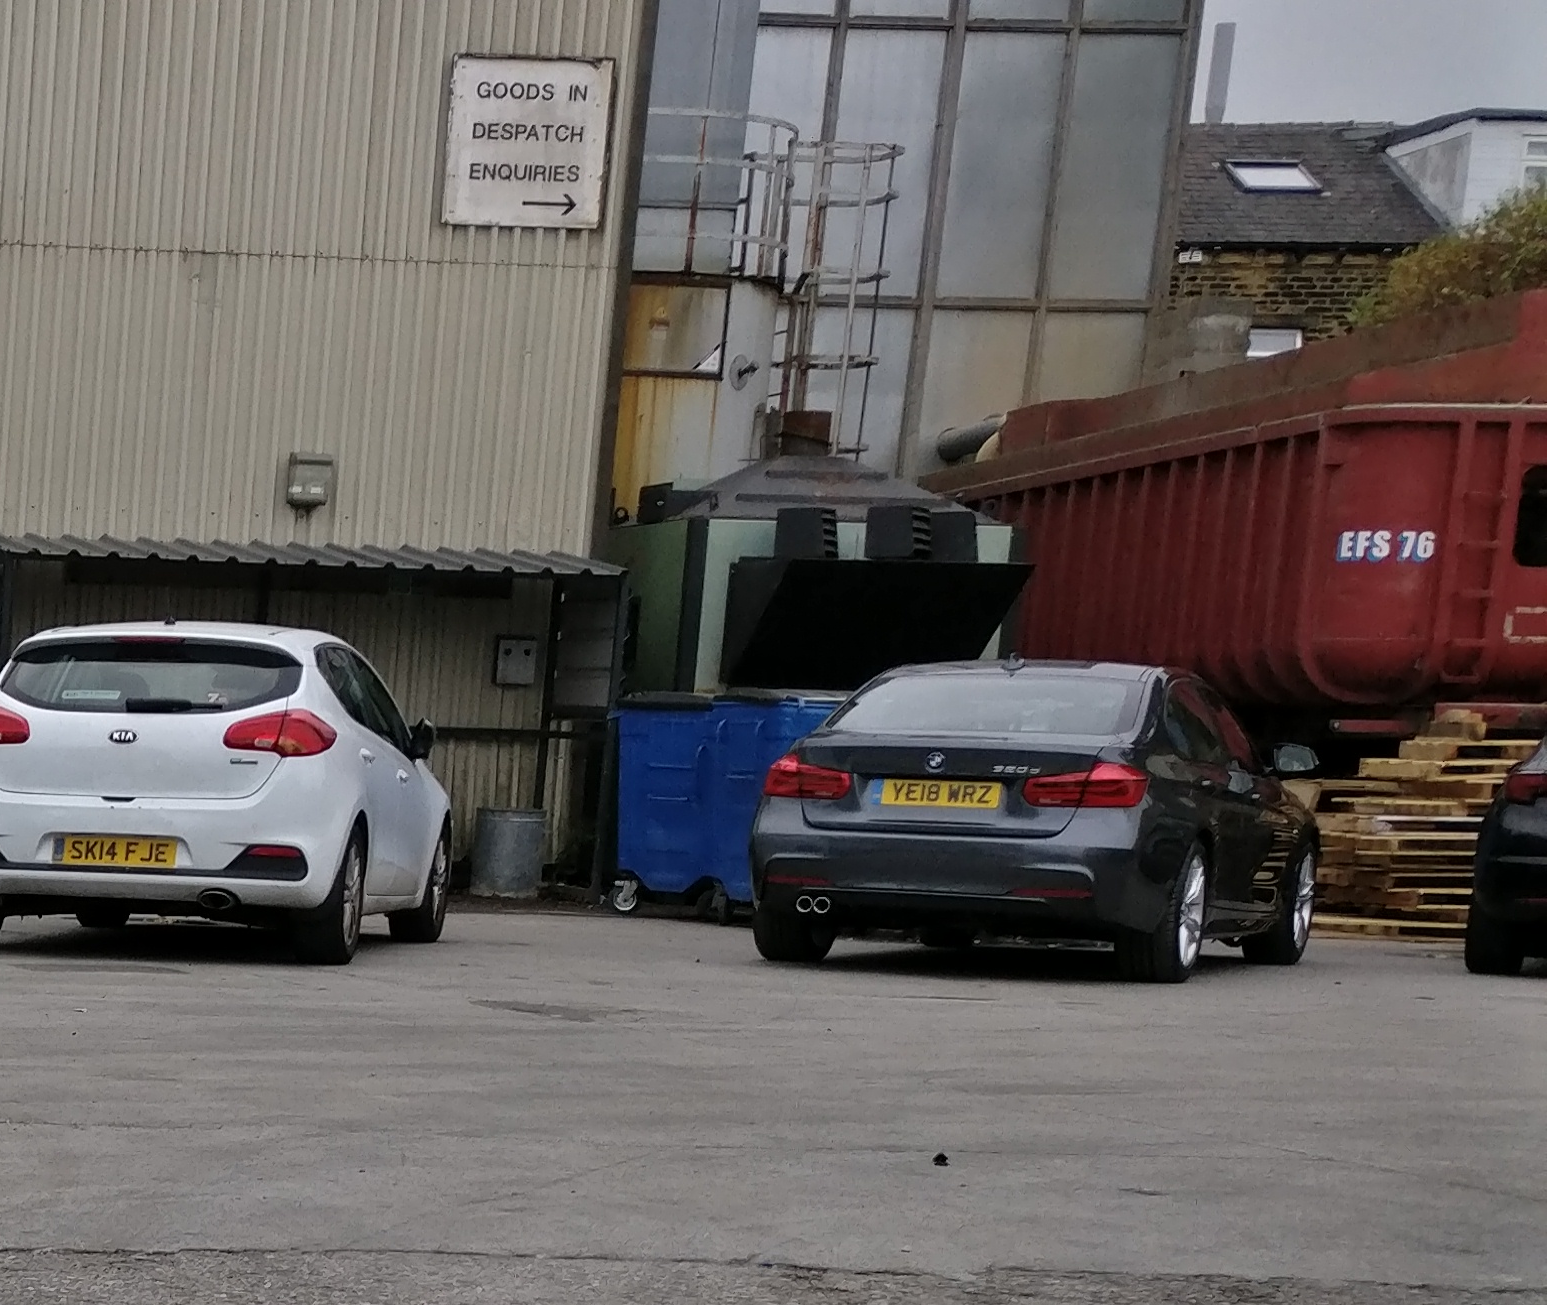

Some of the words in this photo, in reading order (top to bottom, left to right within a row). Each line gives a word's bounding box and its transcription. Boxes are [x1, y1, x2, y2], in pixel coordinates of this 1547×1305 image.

[476, 82, 554, 101] GOODS
[568, 84, 588, 102] IN
[472, 122, 584, 143] DESPATCH
[469, 163, 580, 183] ENQUIRIES
[1337, 530, 1392, 561] EFS
[1398, 530, 1436, 561] 76
[112, 730, 134, 742] KIA
[893, 782, 941, 802] YE18
[947, 784, 992, 804] WRZ
[70, 840, 117, 861] SK14
